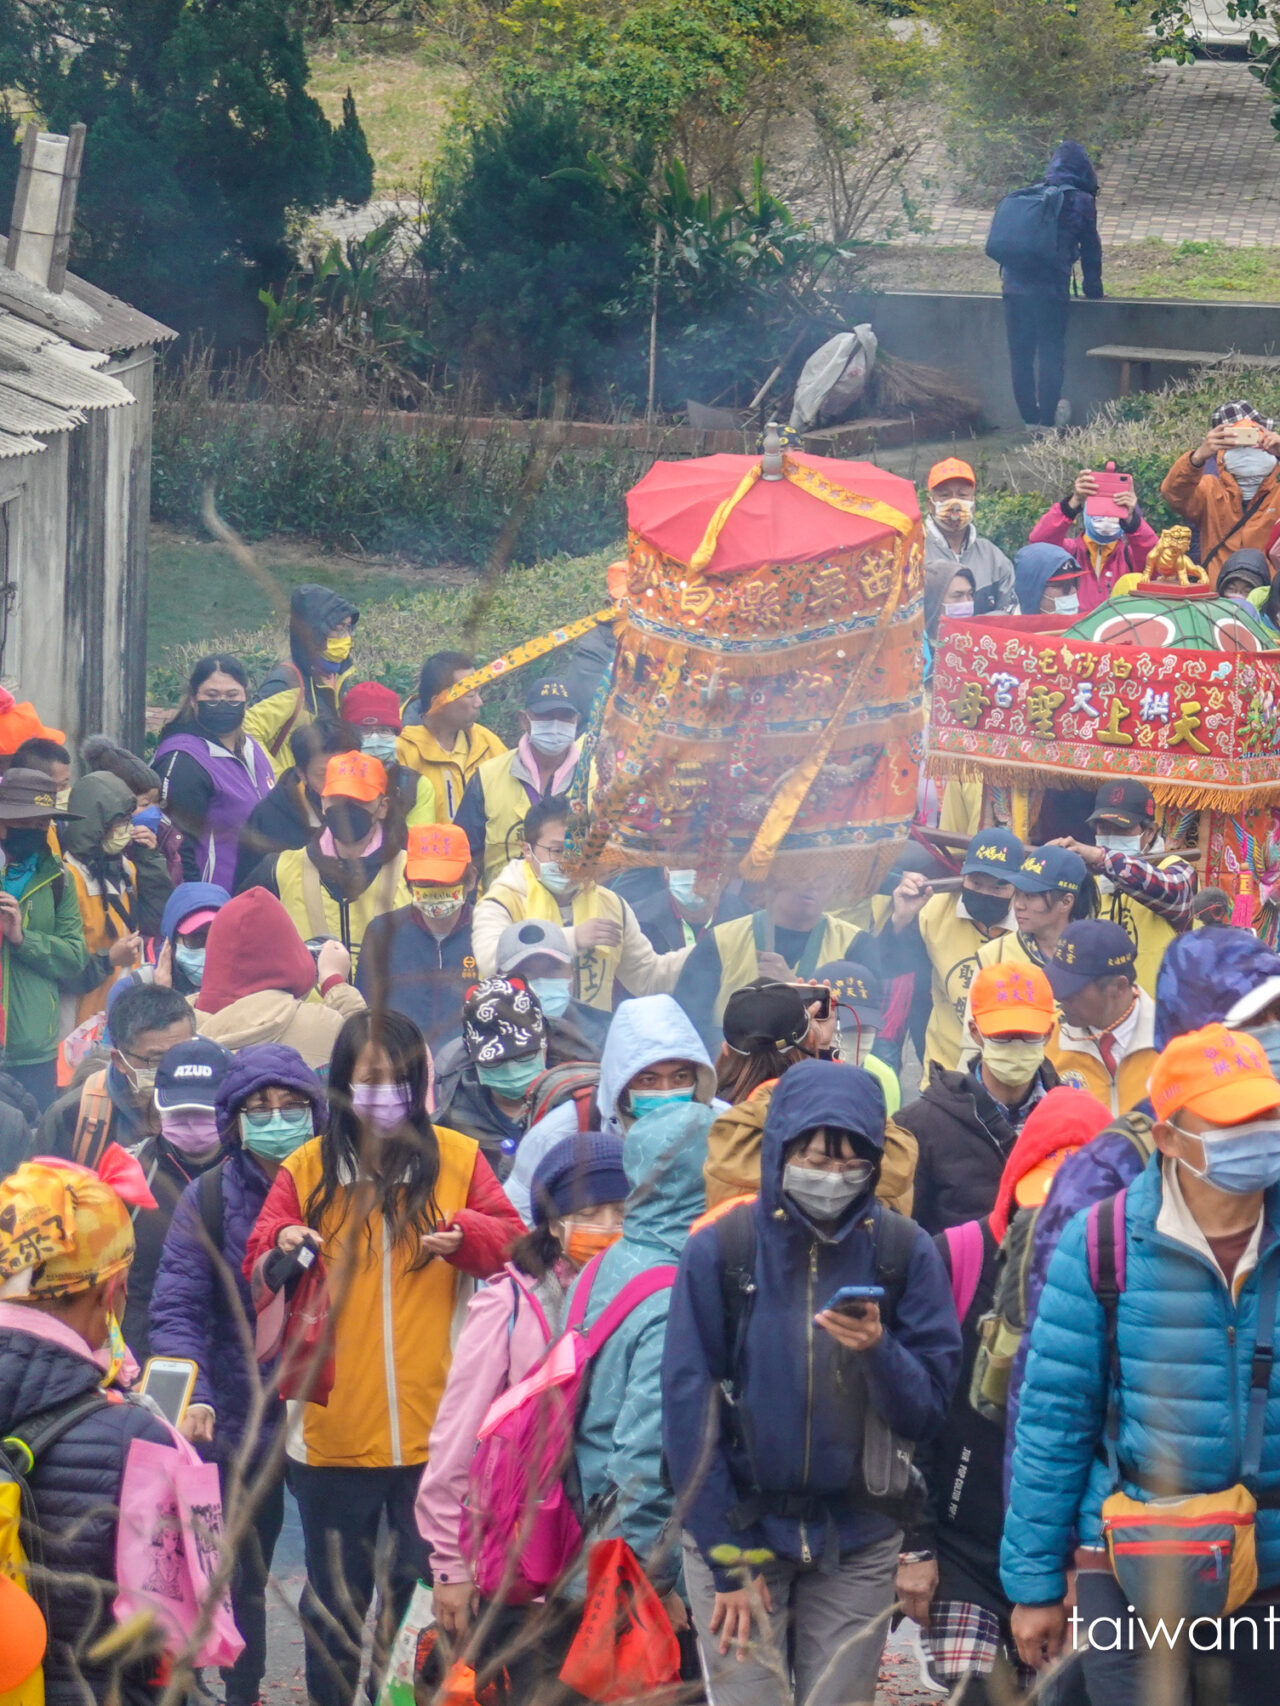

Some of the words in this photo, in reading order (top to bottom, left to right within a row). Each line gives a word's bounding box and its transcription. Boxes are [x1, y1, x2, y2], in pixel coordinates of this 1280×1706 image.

[1038, 647, 1132, 679] 白沙屯
[949, 681, 1211, 755] 天上聖母
[991, 672, 1170, 723] 拱天宮
[173, 1065, 213, 1078] AZUD
